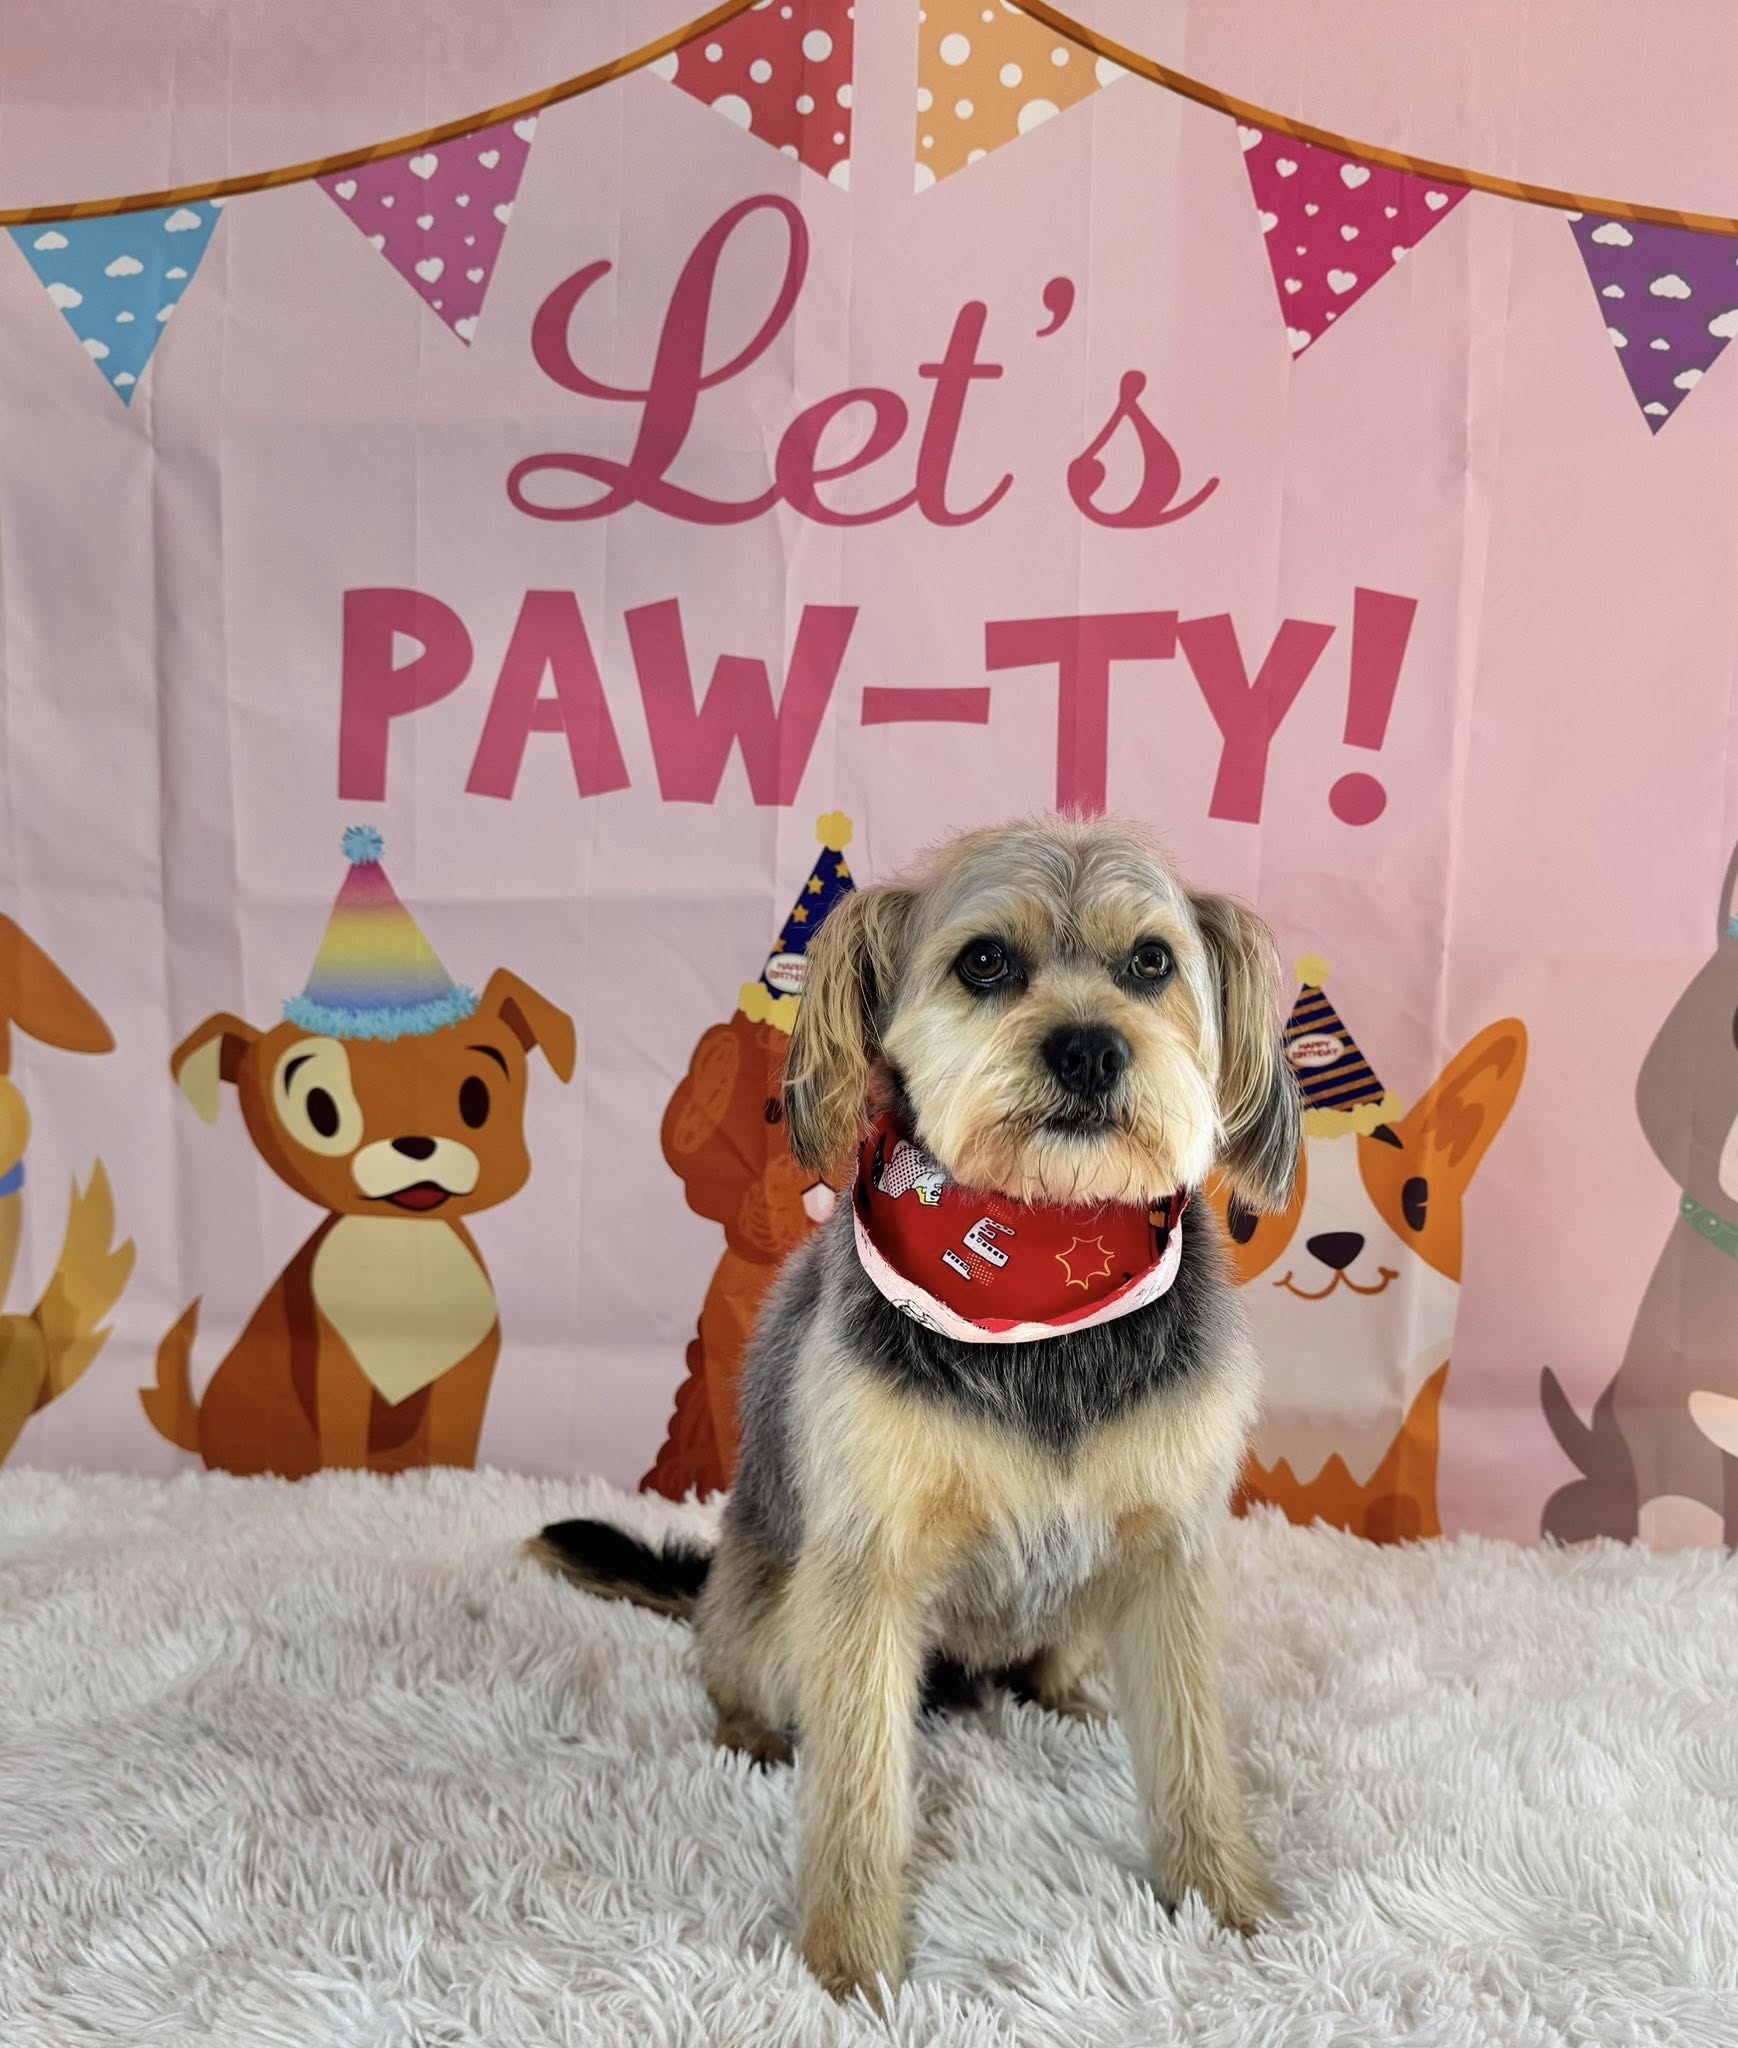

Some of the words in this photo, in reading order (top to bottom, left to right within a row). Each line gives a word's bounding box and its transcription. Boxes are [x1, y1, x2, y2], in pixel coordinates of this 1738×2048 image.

[506, 193, 1220, 529] Let's
[338, 587, 1419, 827] PAW-TY!
[1292, 1047, 1338, 1060] BIRTHDAY
[1298, 1040, 1330, 1050] HAPPY
